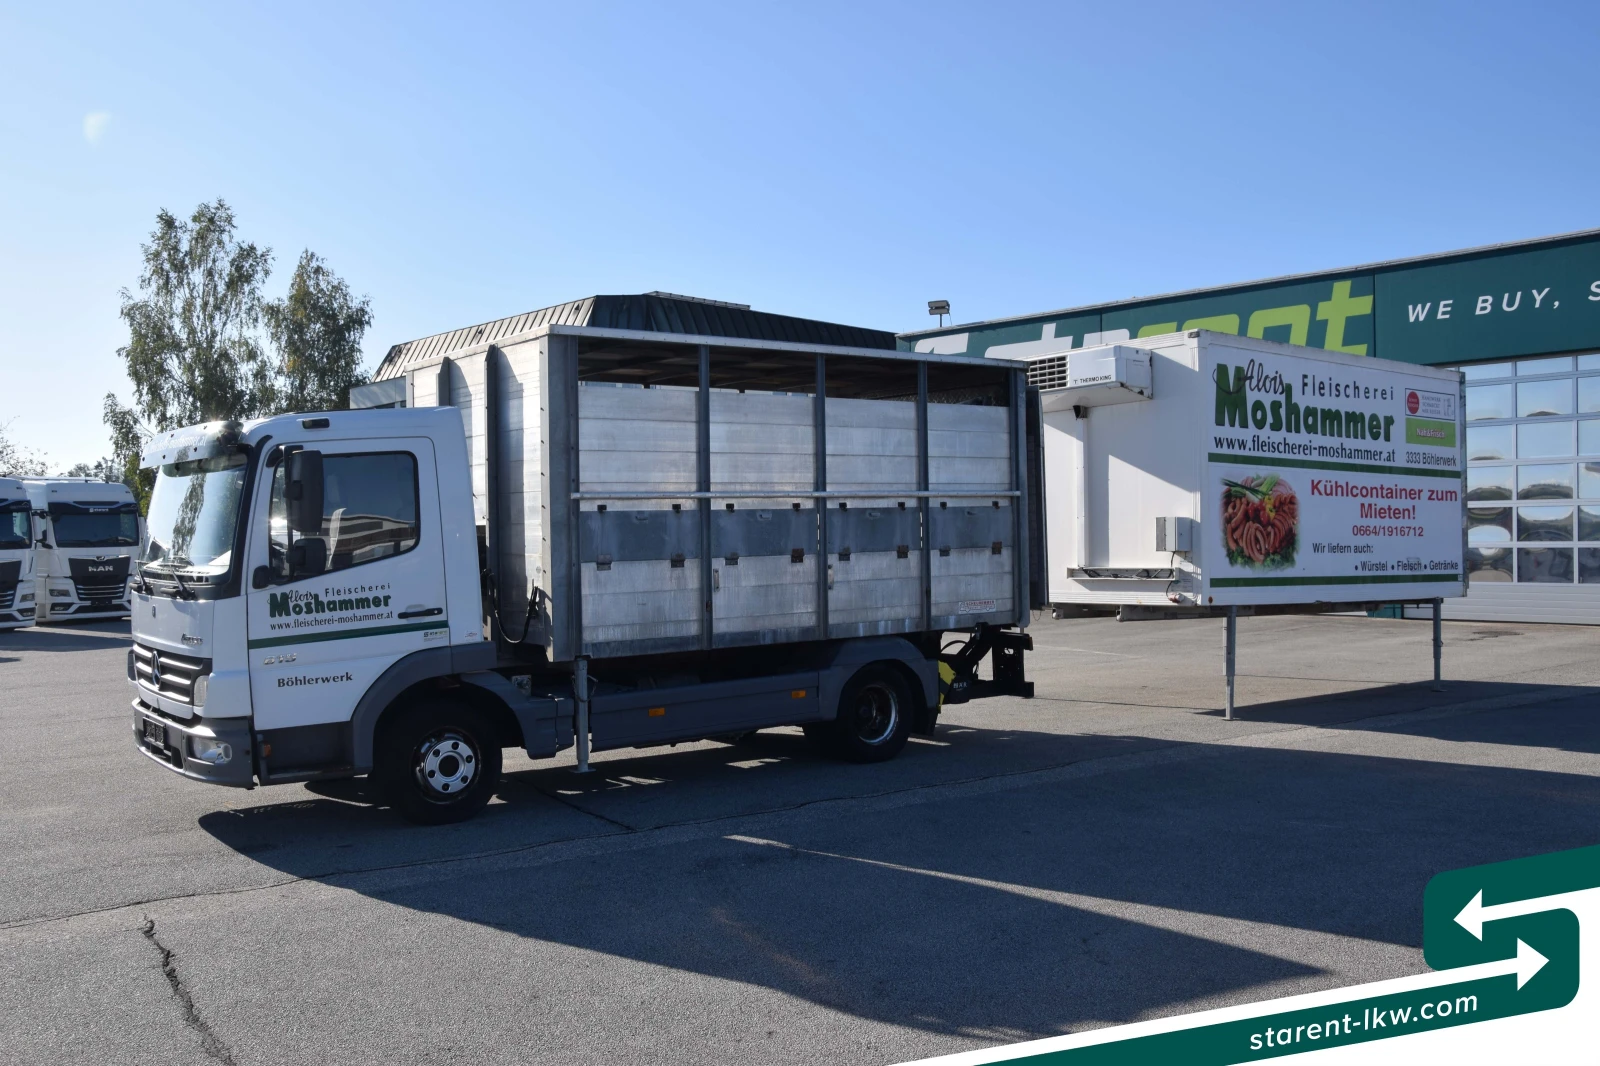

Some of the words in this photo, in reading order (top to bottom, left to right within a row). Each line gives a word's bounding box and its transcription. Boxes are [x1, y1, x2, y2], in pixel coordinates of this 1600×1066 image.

[1408, 300, 1453, 323] WE
[1475, 287, 1560, 316] BUY,
[1301, 374, 1394, 401] Fleischerei
[1214, 363, 1395, 442] Moshammer
[1214, 435, 1395, 463] www.fleischerei-moshammer.at
[1405, 451, 1421, 465] 3333
[1422, 452, 1457, 467] Böhlerwerk
[1310, 479, 1423, 501] Kühlcontainer
[1427, 487, 1458, 502] zum
[1360, 503, 1416, 520] Mieten!
[1352, 525, 1424, 537] 0664/1916712
[1312, 542, 1326, 554] Wir
[1327, 542, 1352, 554] liefern
[1353, 543, 1374, 554] auch:
[1360, 560, 1388, 572] Würstel
[1396, 560, 1422, 572] Fleisch
[1429, 560, 1459, 571] Getränke
[325, 582, 391, 598] Fleischerei
[269, 592, 392, 618] Moshammer
[270, 610, 393, 631] www.fleischerei-moshammer.at
[277, 671, 353, 688] Böhlerwerk
